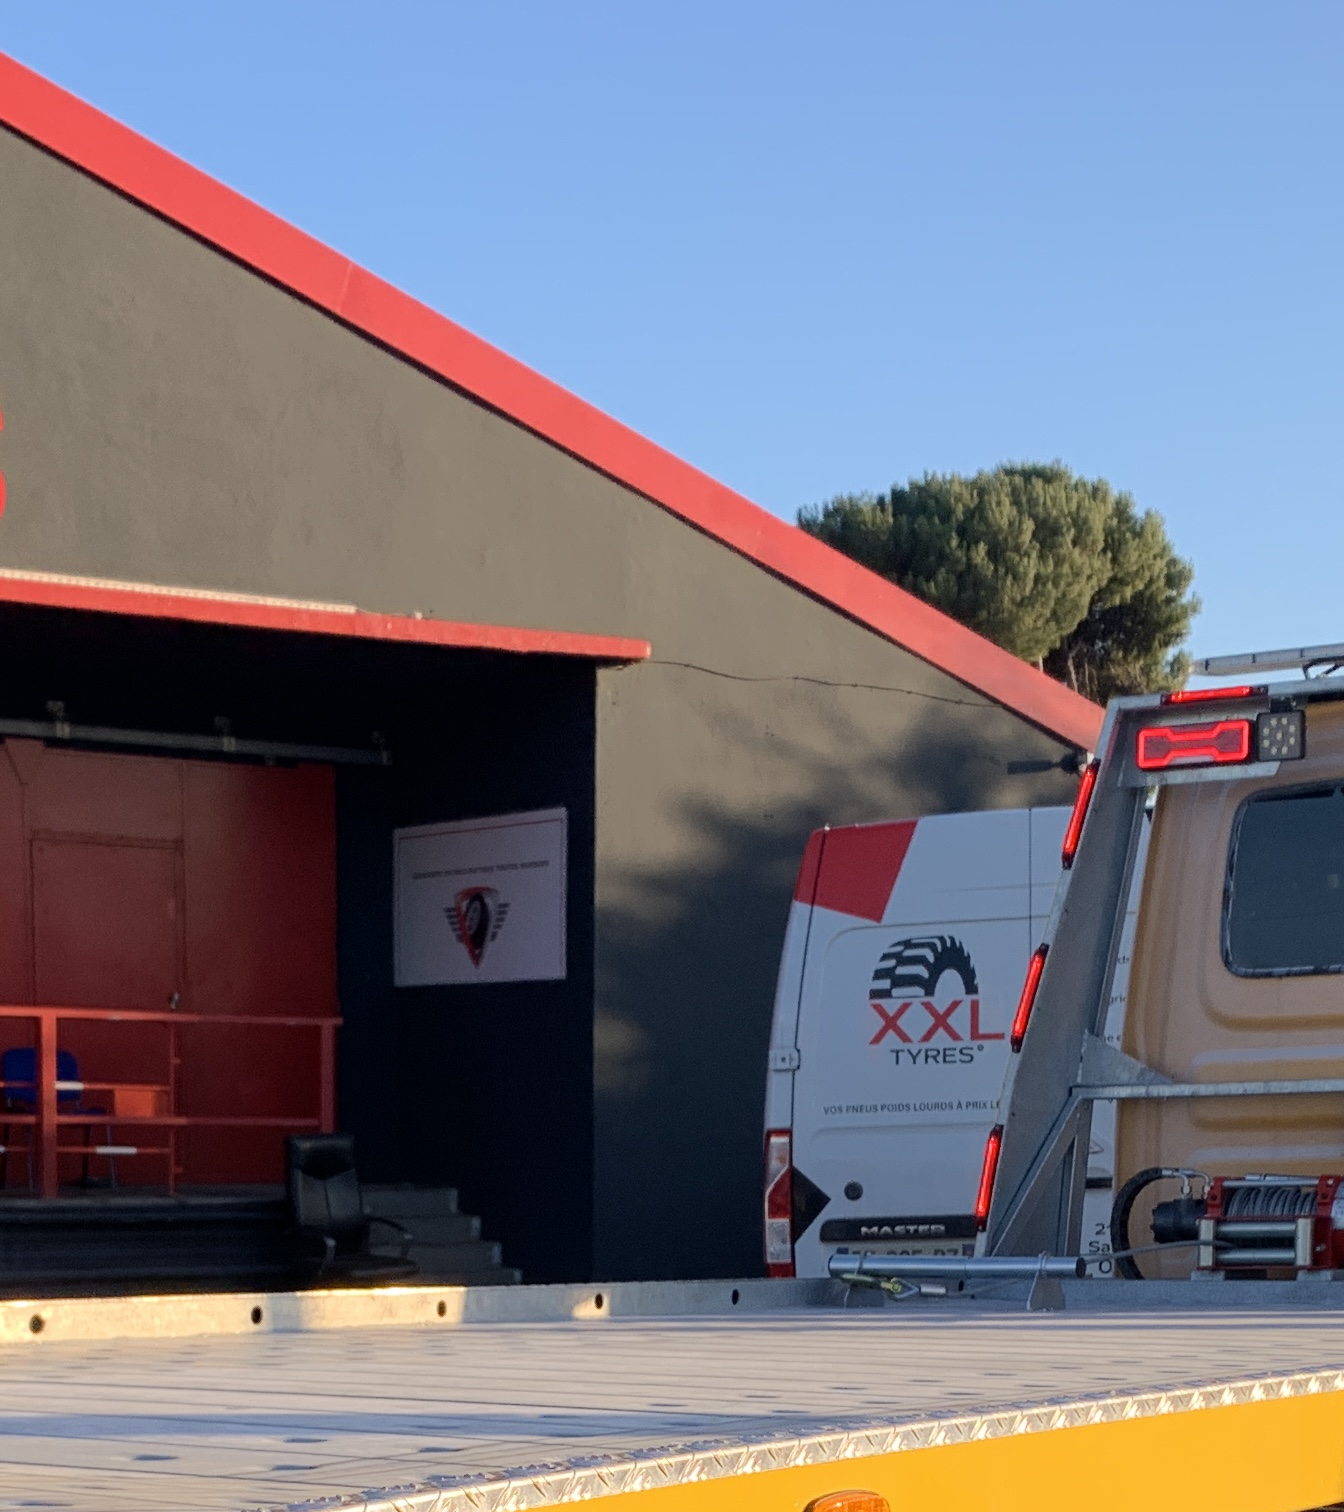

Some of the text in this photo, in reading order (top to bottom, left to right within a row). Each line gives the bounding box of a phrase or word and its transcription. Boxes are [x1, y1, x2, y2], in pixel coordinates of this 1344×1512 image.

[869, 999, 1005, 1045] XXL
[823, 1105, 843, 1115] VOS
[846, 1103, 878, 1114] PNEUS
[880, 1102, 911, 1112] POIDS
[913, 1101, 953, 1111] LOURDS
[966, 1100, 988, 1110] PRIX
[860, 1224, 946, 1237] MASTER
